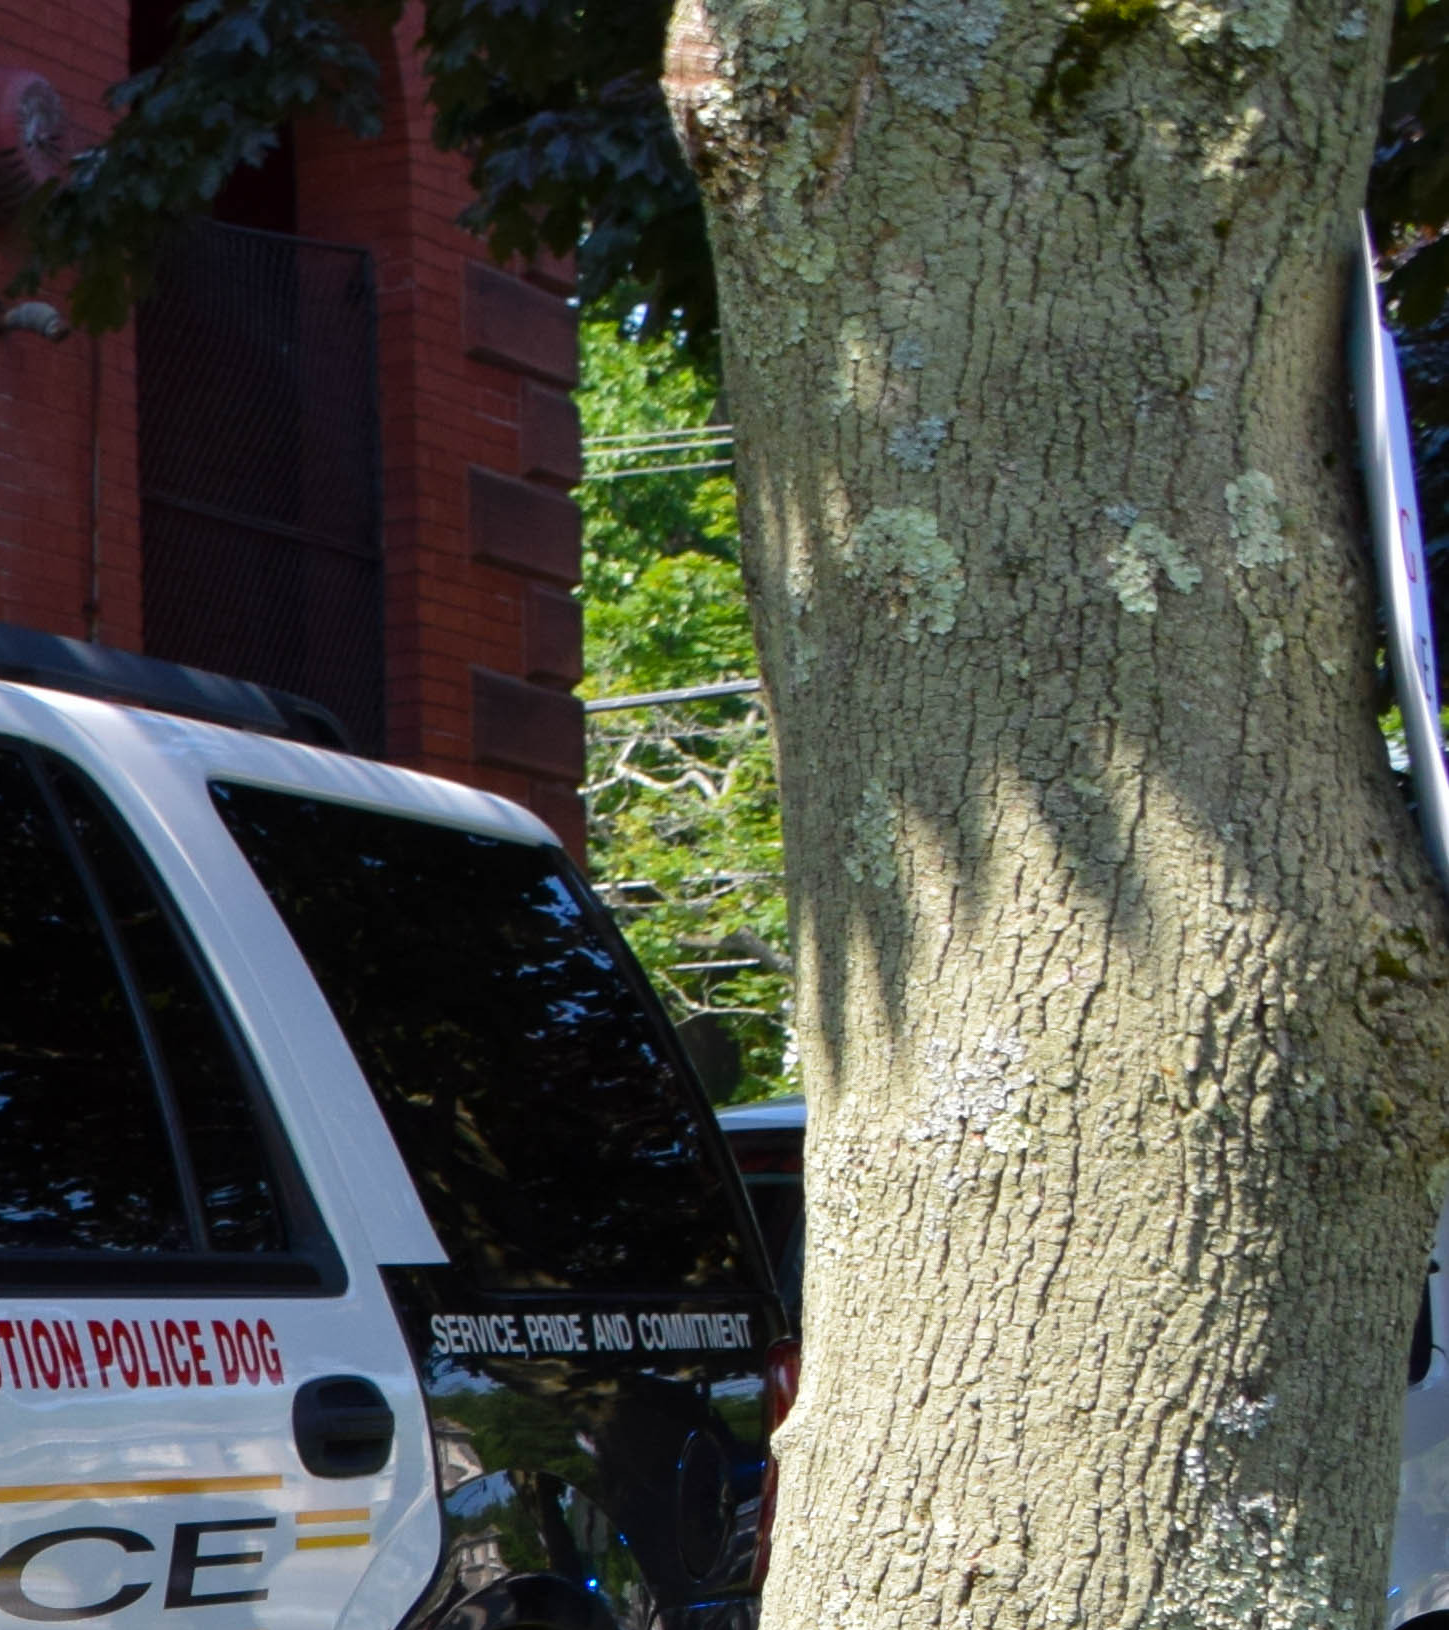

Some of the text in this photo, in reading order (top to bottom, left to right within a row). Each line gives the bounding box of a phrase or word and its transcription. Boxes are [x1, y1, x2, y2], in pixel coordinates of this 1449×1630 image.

[87, 1319, 213, 1389] POLICE
[211, 1318, 284, 1386] DOG
[431, 1313, 751, 1360] SERVICE, PRIDE AND COMMITMENT
